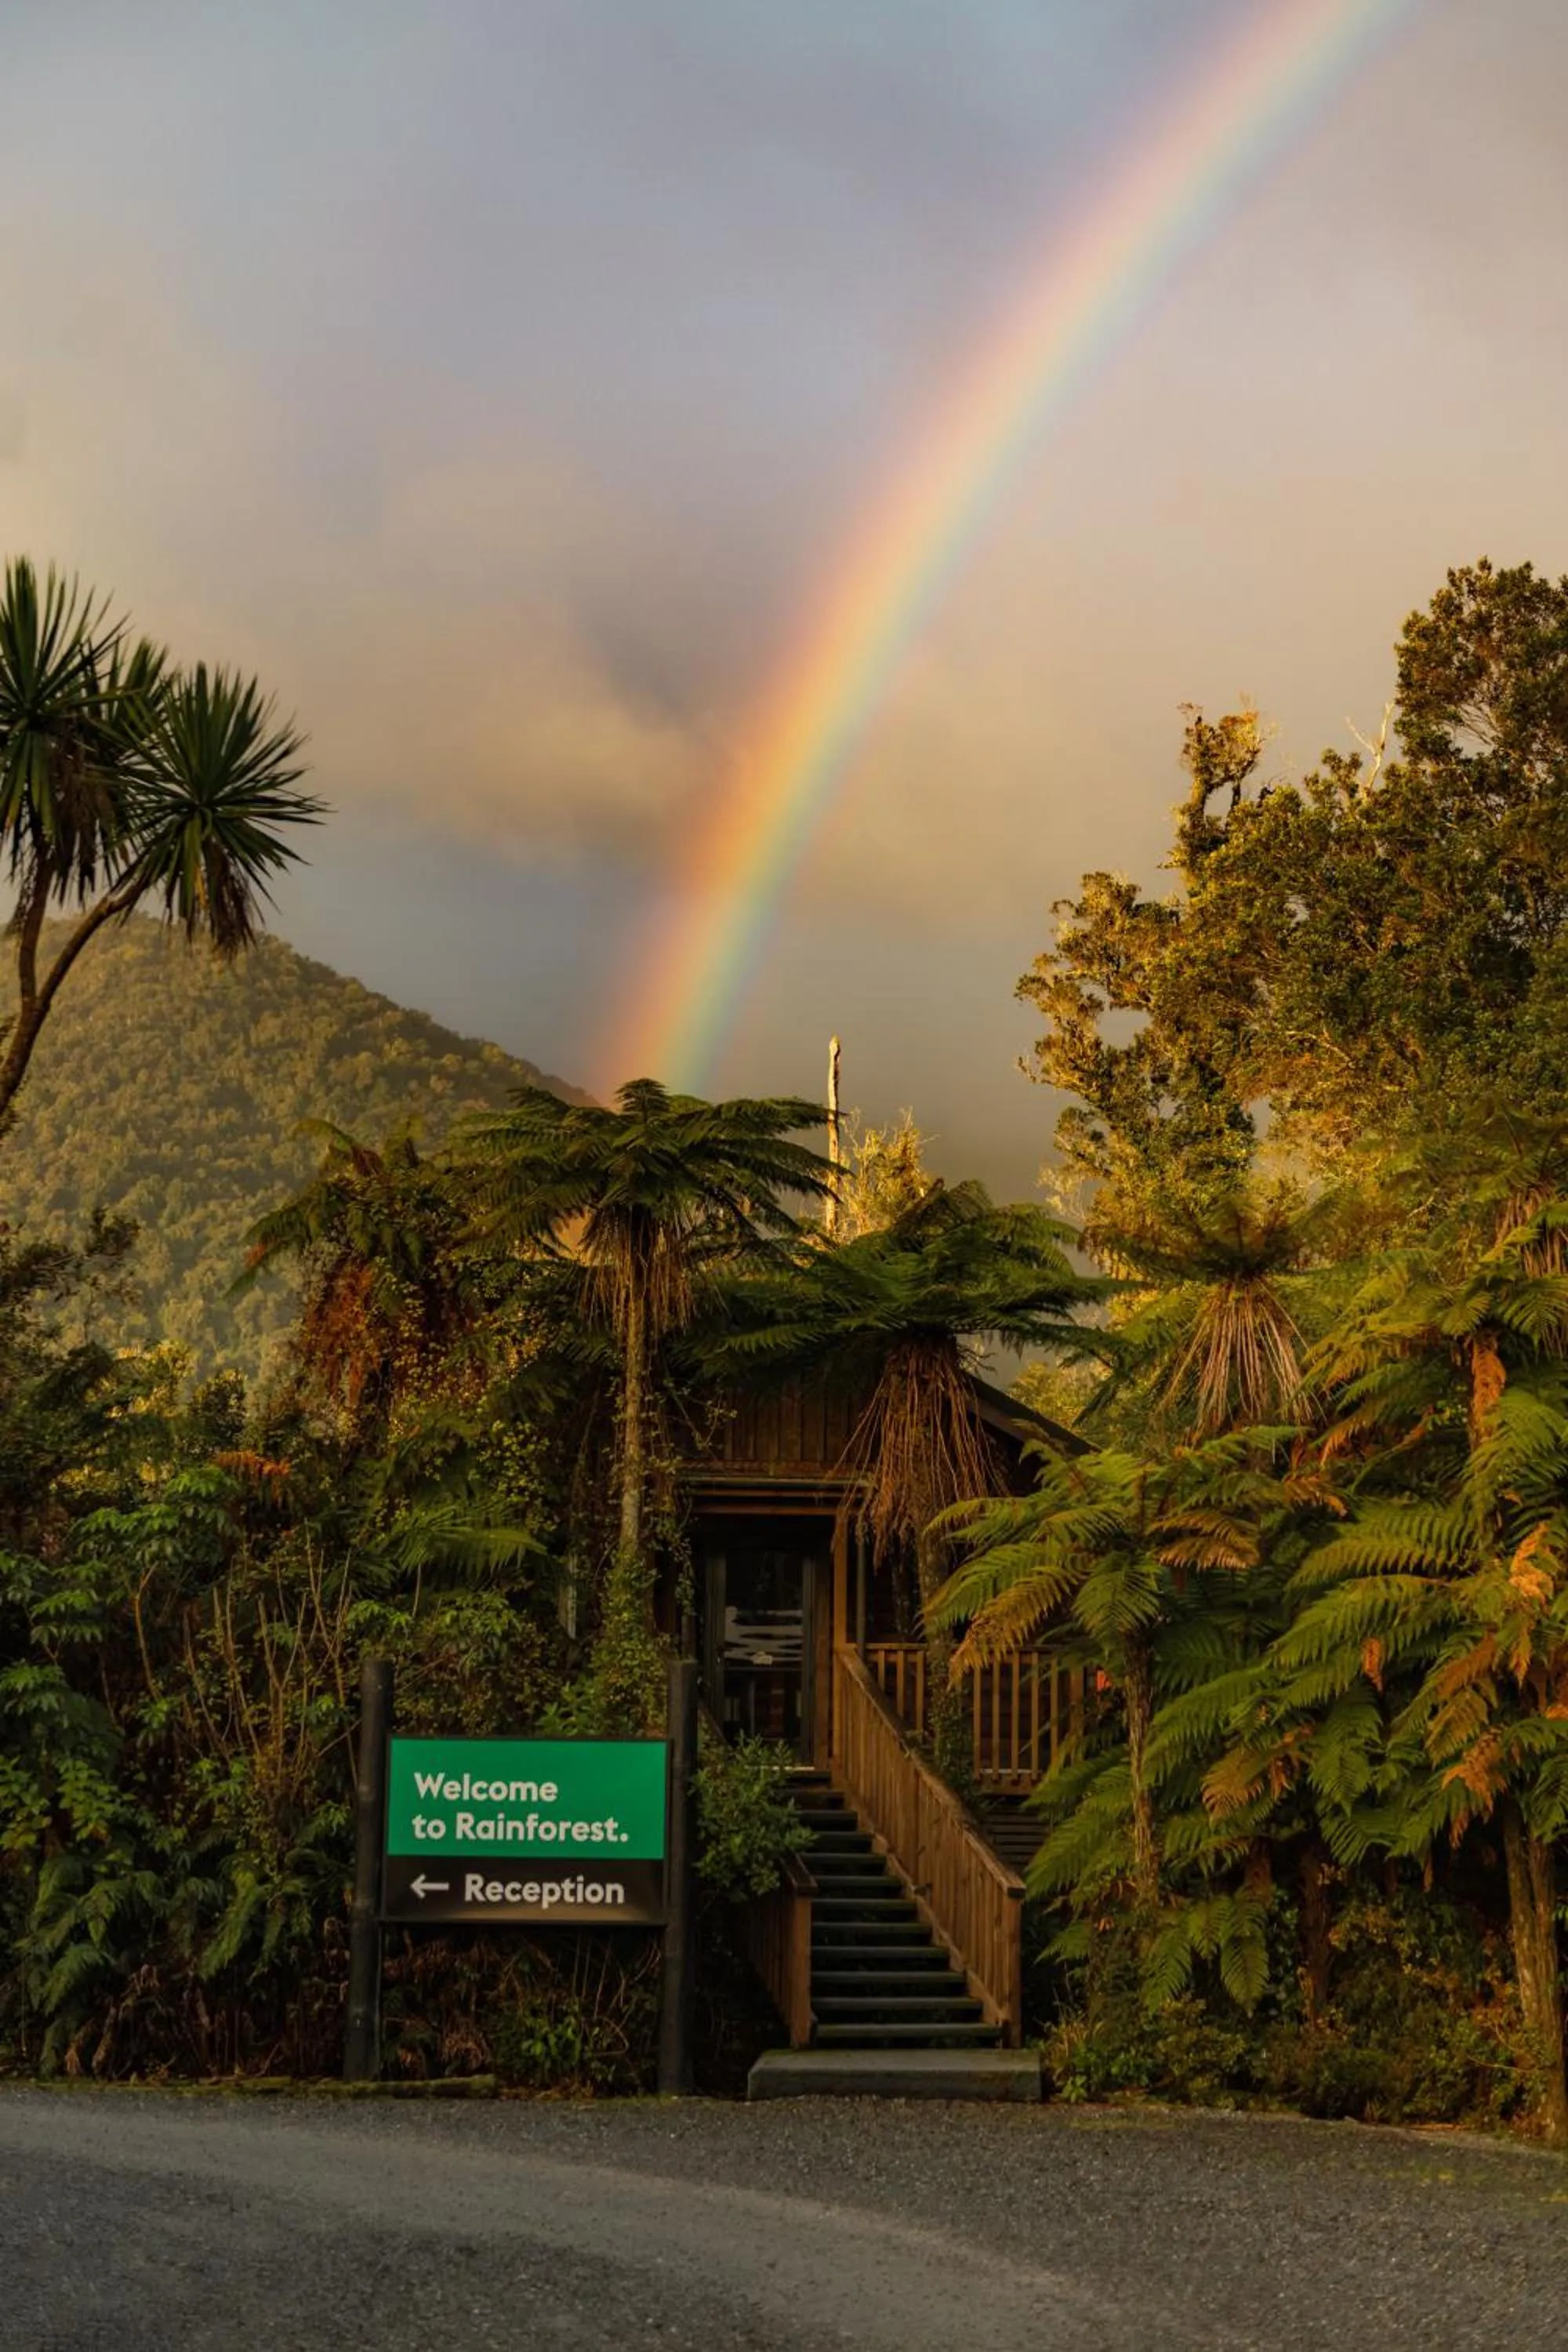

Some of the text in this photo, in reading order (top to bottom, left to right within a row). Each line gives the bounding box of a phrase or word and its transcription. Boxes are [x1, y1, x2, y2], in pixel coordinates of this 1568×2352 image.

[414, 1773, 558, 1802] Welcome
[412, 1813, 629, 1842] to Rainforest.
[465, 1874, 625, 1909] Reception
